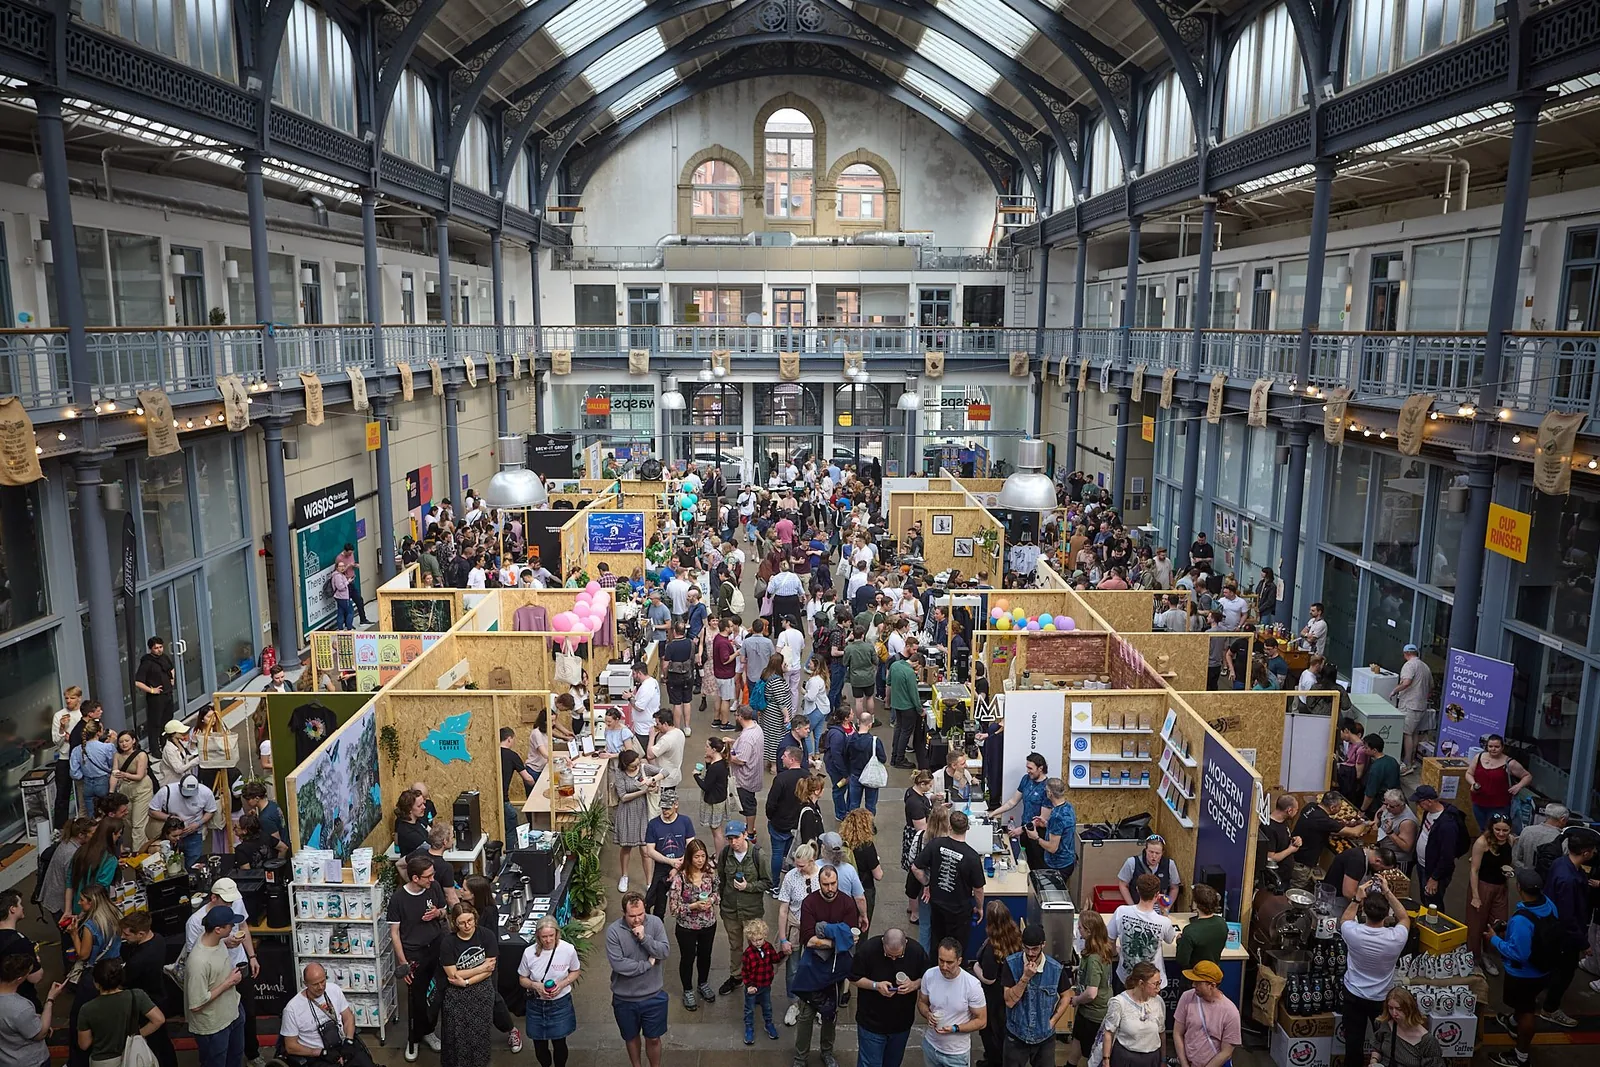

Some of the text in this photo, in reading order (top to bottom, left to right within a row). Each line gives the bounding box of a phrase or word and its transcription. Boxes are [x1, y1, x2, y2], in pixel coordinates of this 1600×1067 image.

[303, 496, 334, 519] wasps
[1499, 516, 1516, 532] CUP
[1491, 528, 1522, 553] RINSER
[307, 574, 326, 591] There's
[308, 594, 319, 607] The
[309, 603, 336, 623] than meets
[1452, 674, 1476, 686] LOCAL
[1453, 666, 1488, 681] SUPPORT
[1450, 690, 1460, 698] AT
[1468, 695, 1486, 706] TIME
[1451, 682, 1493, 699] ONE STAMP
[1208, 758, 1244, 807] MODERN
[1204, 774, 1245, 829] STANDARD
[1207, 799, 1237, 844] COFFEE
[1454, 1044, 1474, 1052] Coffee
